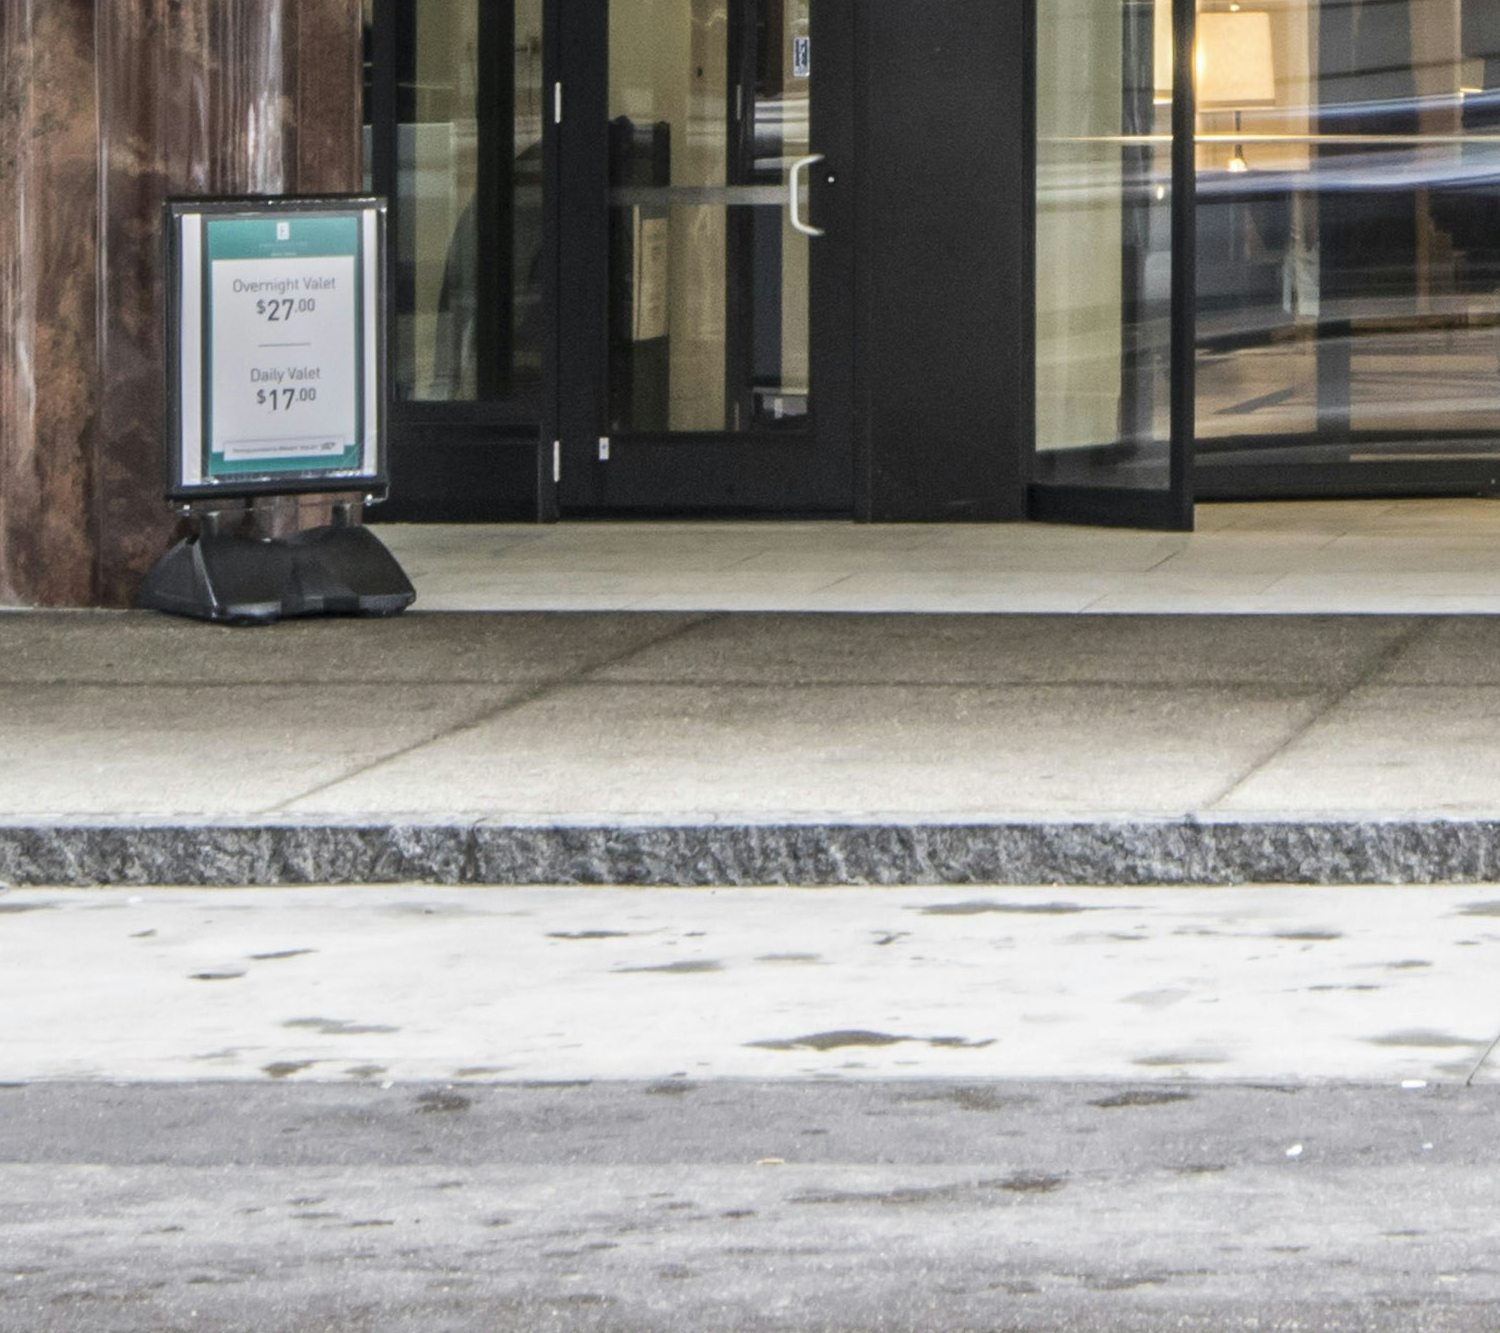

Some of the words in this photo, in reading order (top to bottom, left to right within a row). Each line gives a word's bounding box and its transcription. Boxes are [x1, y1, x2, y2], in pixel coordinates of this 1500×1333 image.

[232, 278, 299, 295] Overnight
[303, 277, 336, 290] Valet
[256, 296, 316, 323] $27.00
[250, 366, 285, 385] Daily
[287, 365, 322, 381] Valet
[256, 386, 317, 412] $17.00
